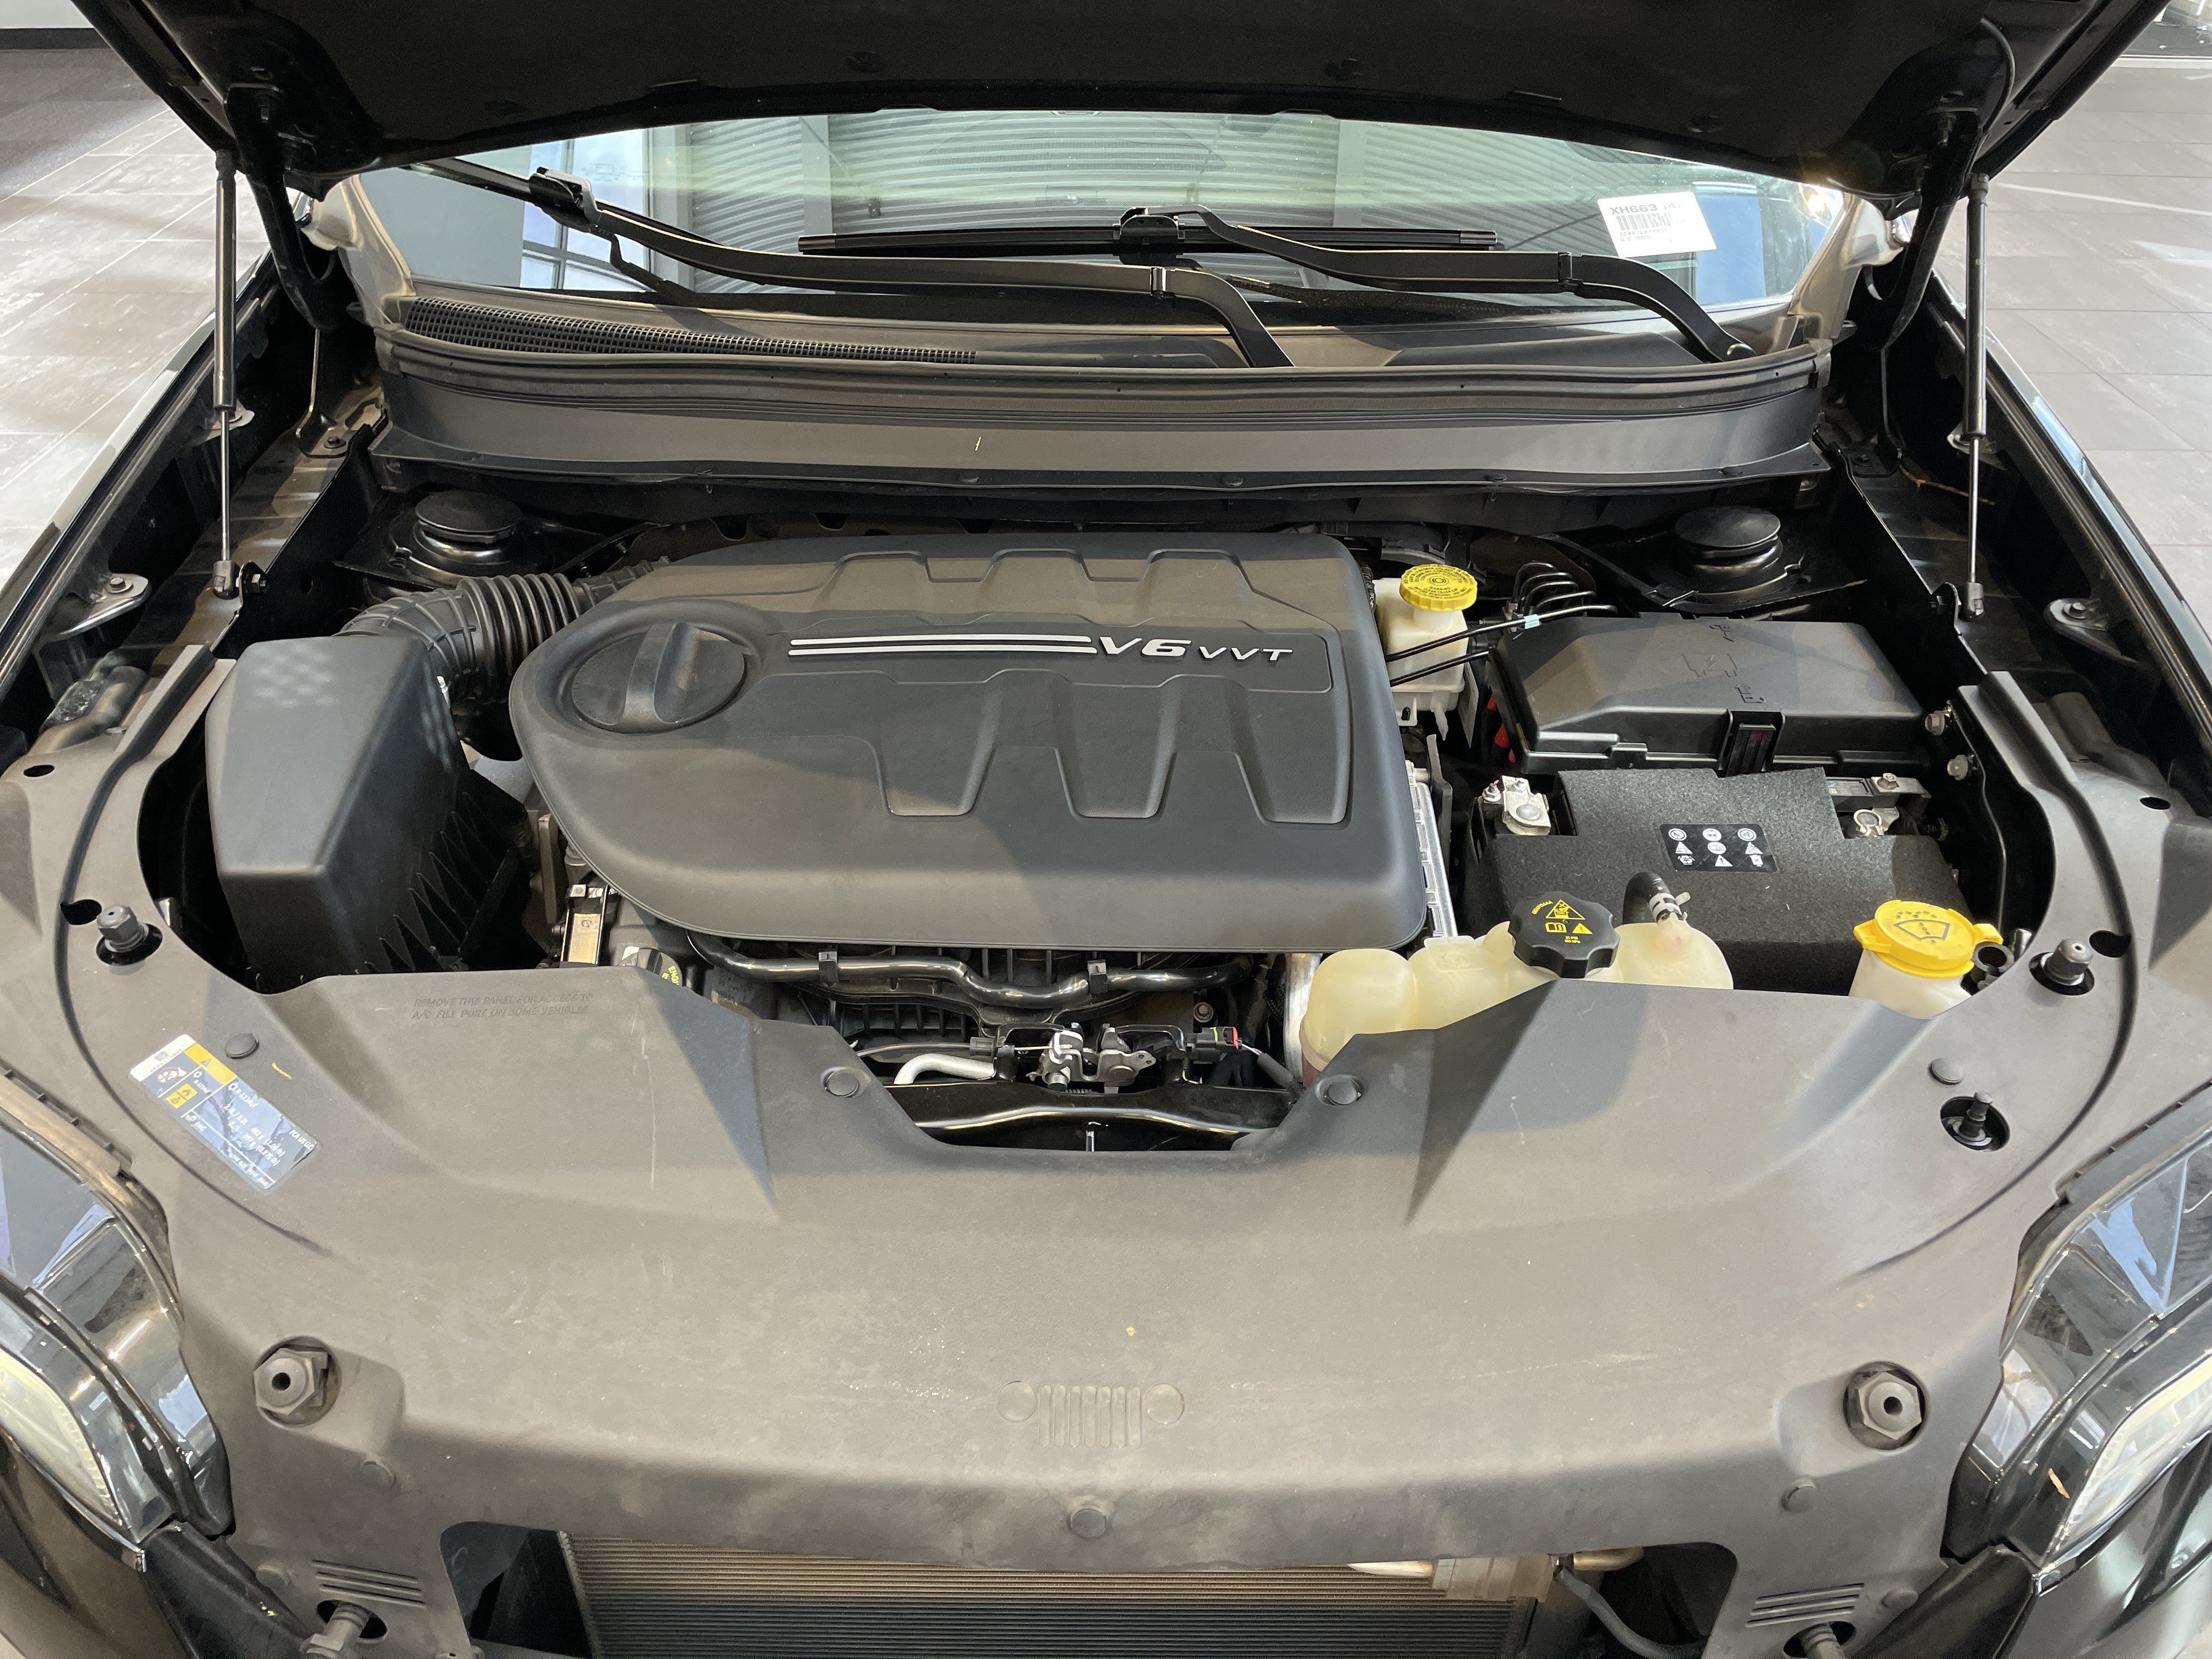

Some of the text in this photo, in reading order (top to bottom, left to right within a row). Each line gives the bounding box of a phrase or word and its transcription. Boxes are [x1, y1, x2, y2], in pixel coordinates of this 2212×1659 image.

[1099, 636, 1293, 661] V6 VVT
[668, 966, 679, 985] ENGI
